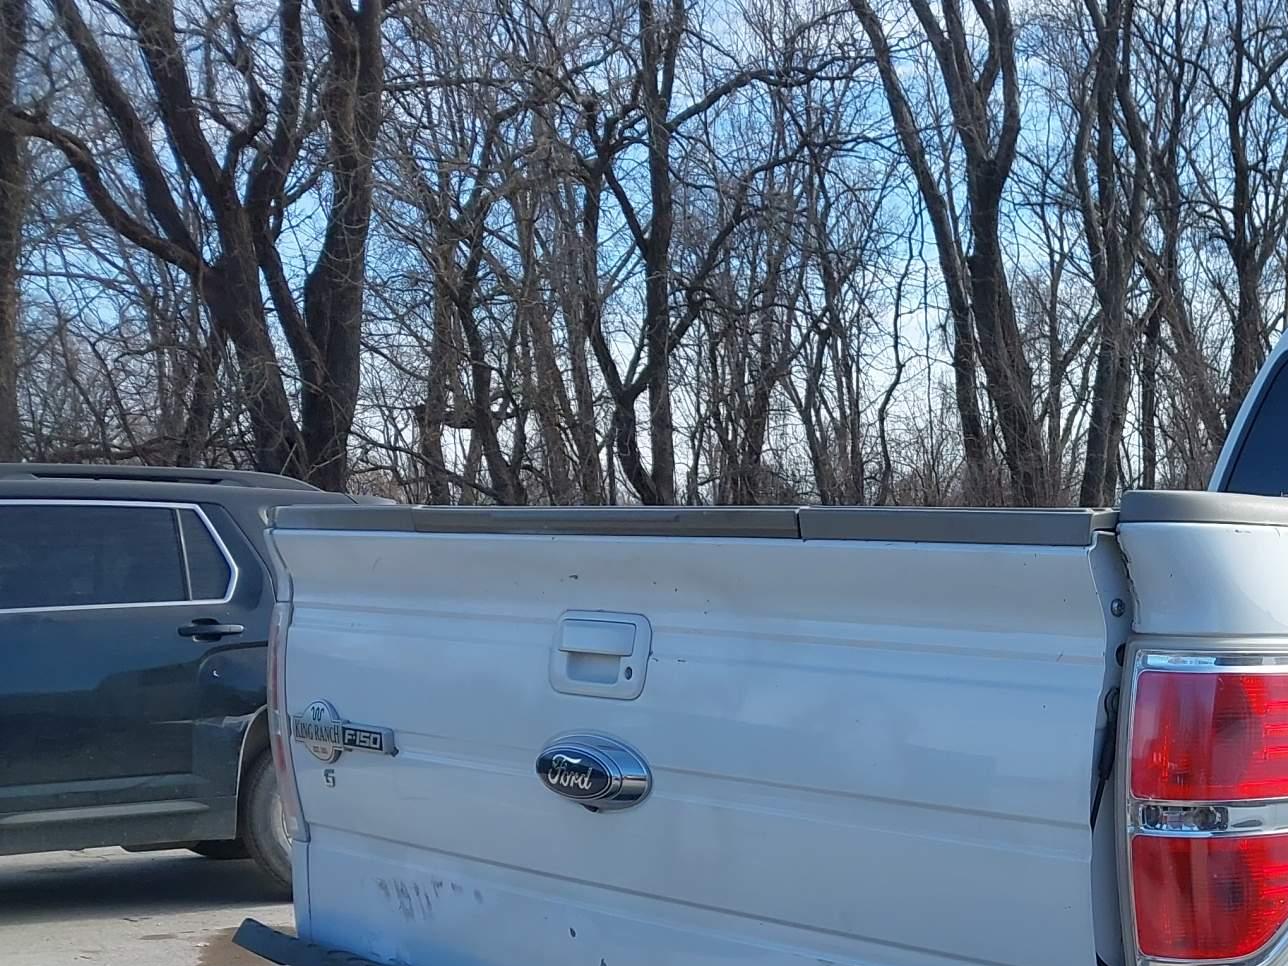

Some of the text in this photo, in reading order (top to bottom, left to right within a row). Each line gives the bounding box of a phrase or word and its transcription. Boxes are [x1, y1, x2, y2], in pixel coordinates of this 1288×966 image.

[294, 718, 340, 746] KING RANCH
[344, 729, 381, 749] F-150
[548, 753, 593, 791] Ford
